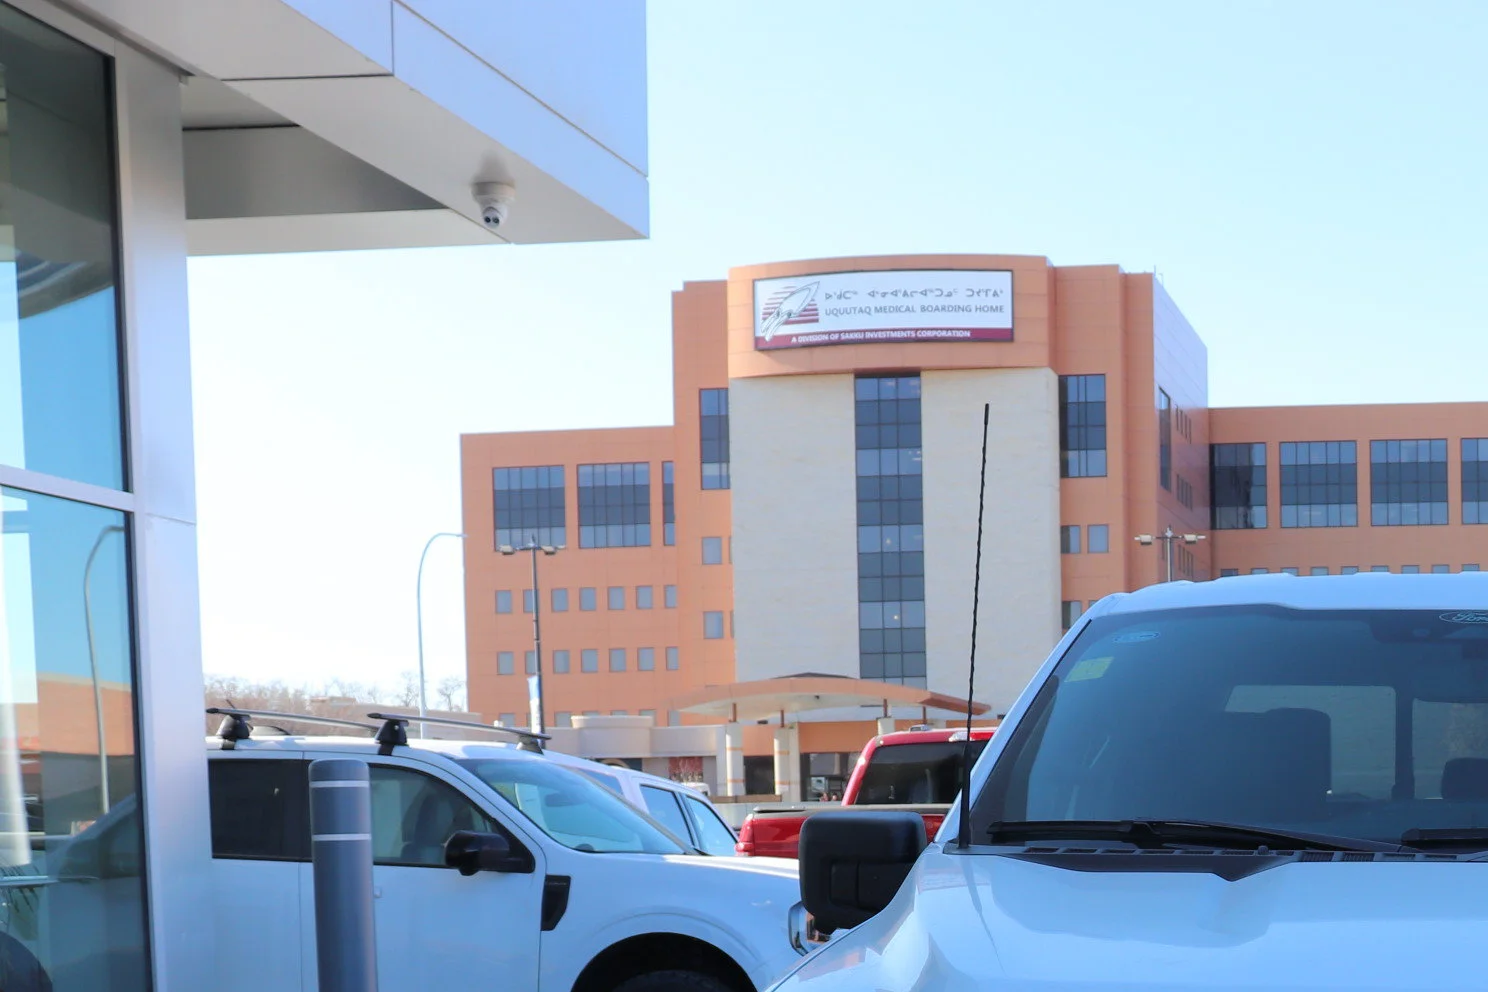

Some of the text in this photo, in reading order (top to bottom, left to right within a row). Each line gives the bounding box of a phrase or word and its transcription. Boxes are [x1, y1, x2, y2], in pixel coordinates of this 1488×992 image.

[825, 304, 1005, 317] UQUUTAQ MEDICAL BOARDING HOME
[791, 329, 971, 344] A DIVISION OF SAKKU INVESTMENTS CORPORATION
